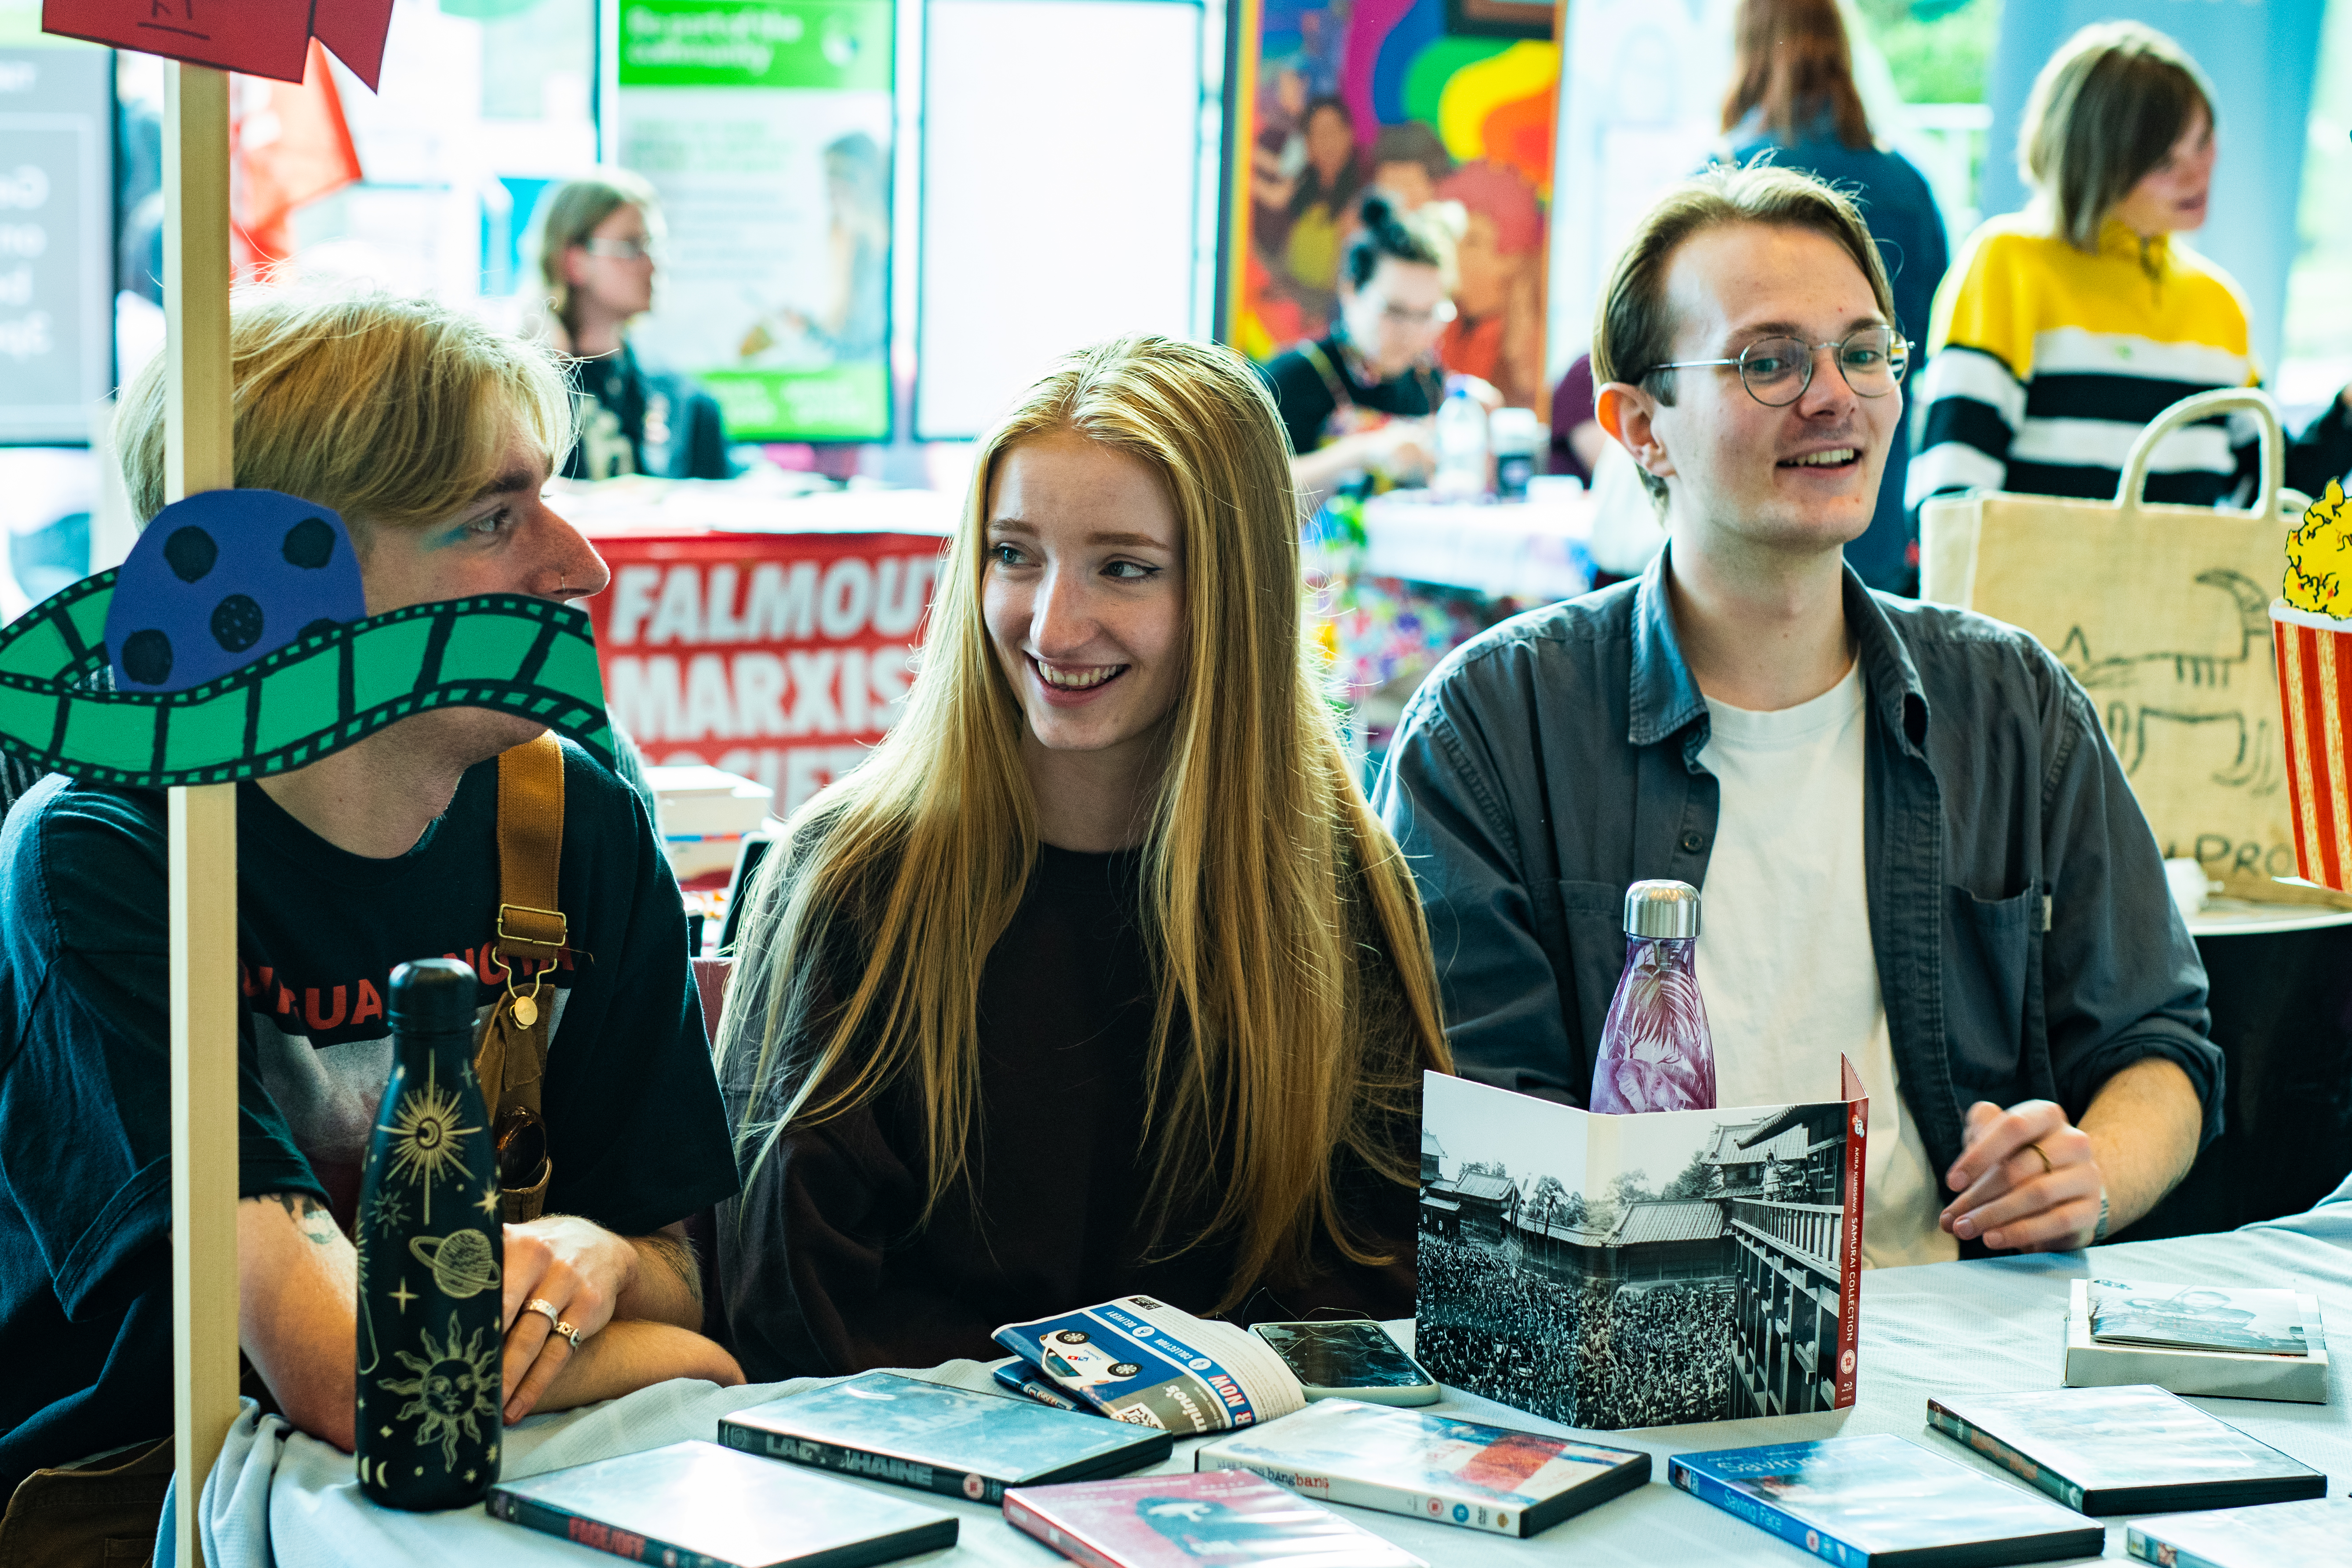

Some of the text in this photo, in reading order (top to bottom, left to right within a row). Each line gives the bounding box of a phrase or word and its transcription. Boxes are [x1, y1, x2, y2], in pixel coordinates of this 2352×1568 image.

[1850, 1218, 1858, 1268] SAMURAI
[1105, 1310, 1138, 1329] DELIVERY
[1847, 1272, 1855, 1342] COLLECTION
[1154, 1338, 1194, 1360] COLLECTION
[1165, 1385, 1208, 1433] mino's
[1208, 1374, 1246, 1408] NOW
[851, 1452, 934, 1486] HAINE
[1723, 1488, 1784, 1532] Saving Face
